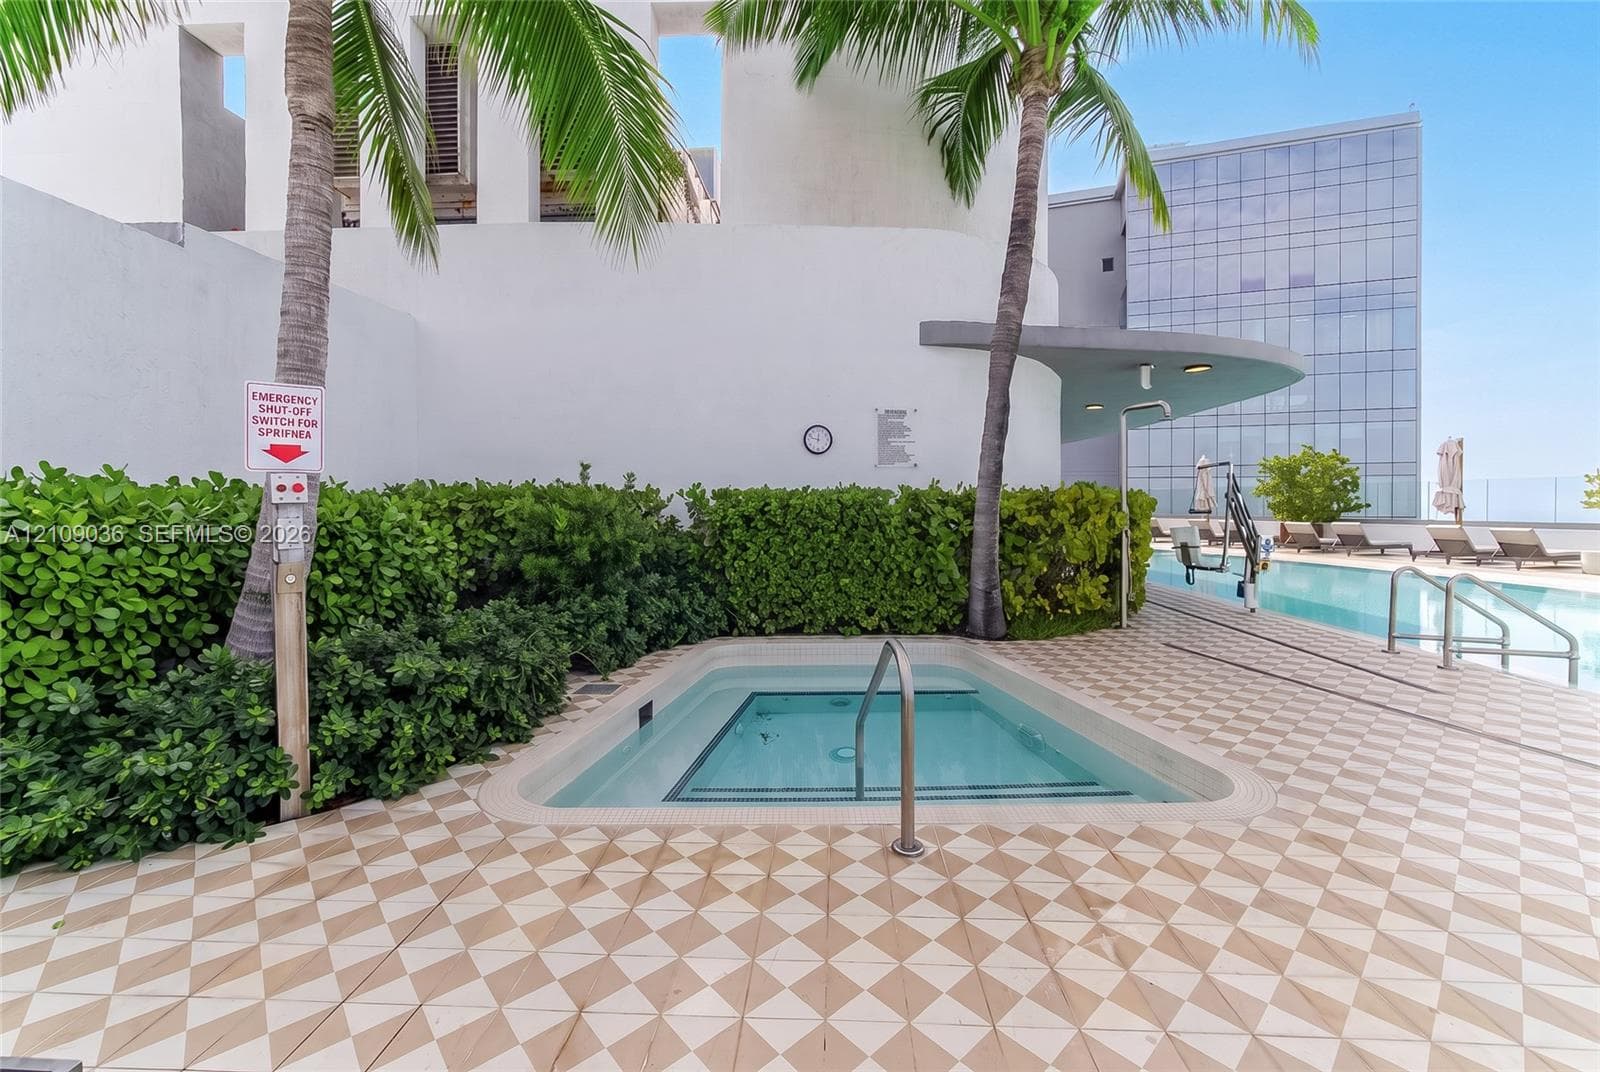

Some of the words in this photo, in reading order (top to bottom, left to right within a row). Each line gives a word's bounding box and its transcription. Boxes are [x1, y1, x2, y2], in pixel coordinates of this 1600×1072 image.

[252, 391, 318, 406] EMERGENCY
[258, 404, 312, 417] SHUT-OFF
[252, 416, 294, 427] SWITCH
[298, 418, 318, 428] FOR
